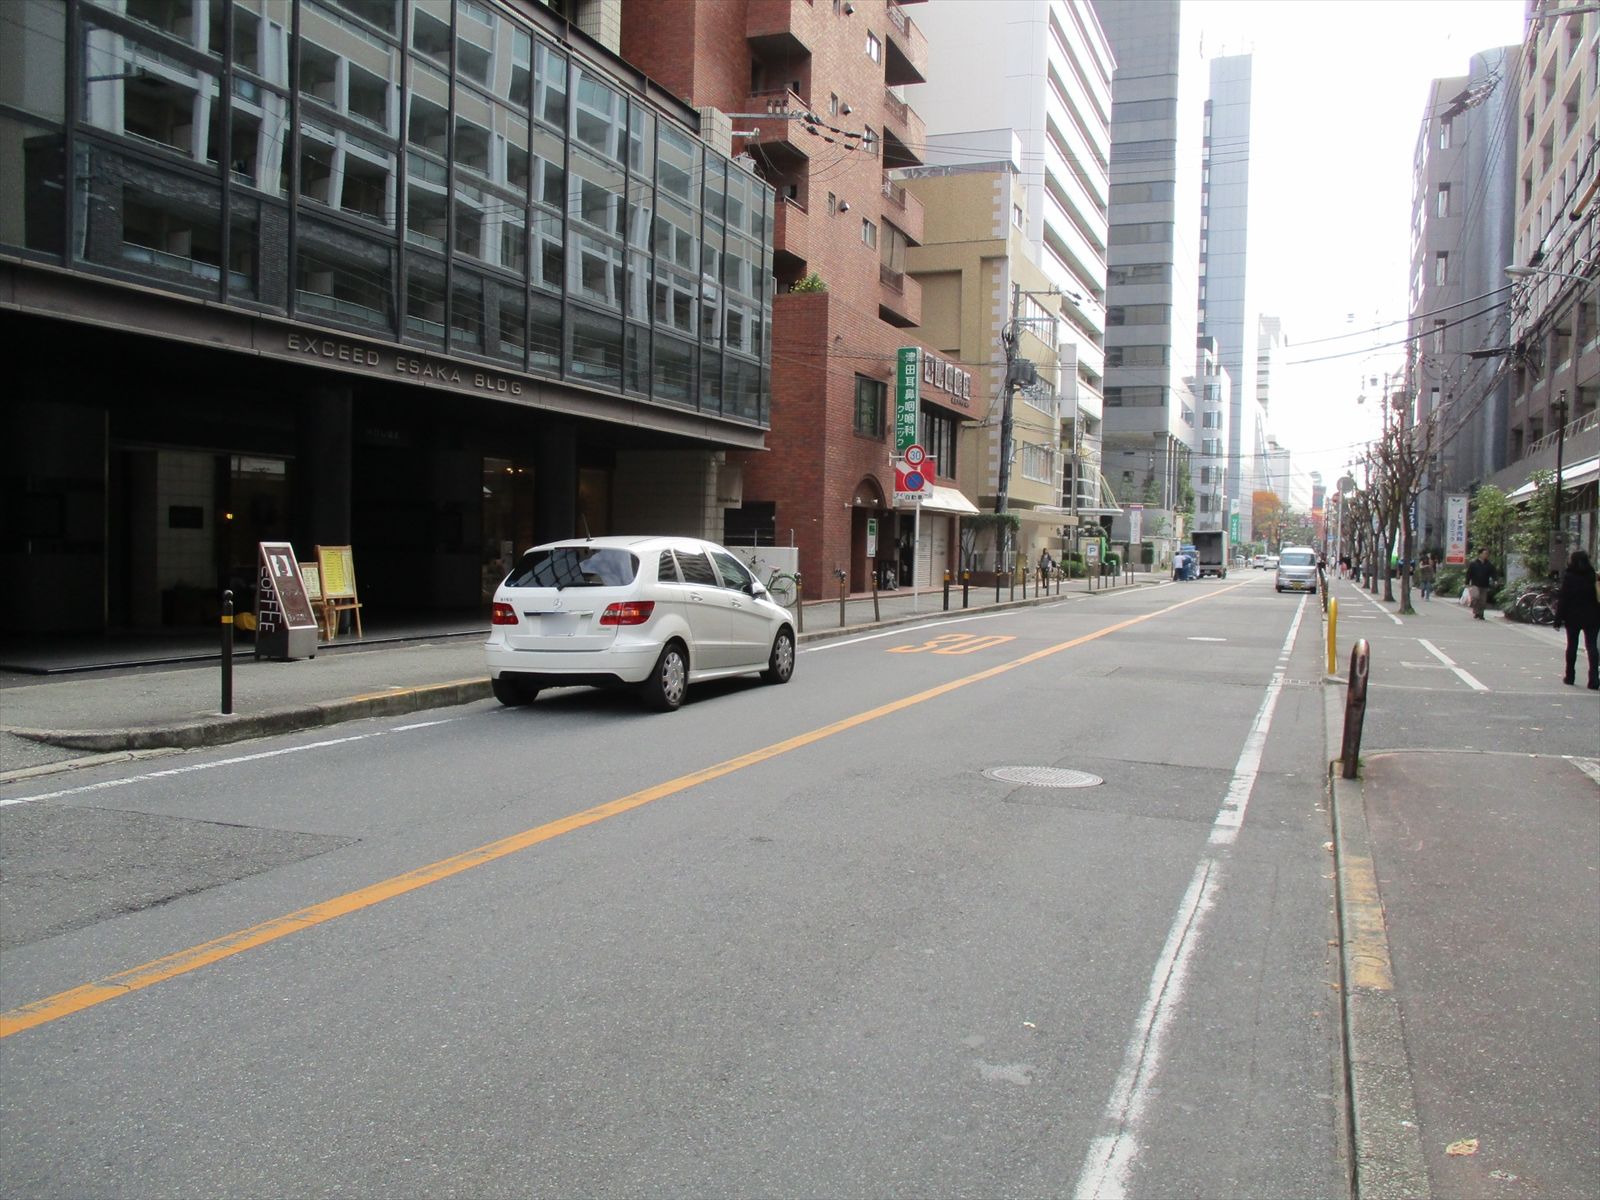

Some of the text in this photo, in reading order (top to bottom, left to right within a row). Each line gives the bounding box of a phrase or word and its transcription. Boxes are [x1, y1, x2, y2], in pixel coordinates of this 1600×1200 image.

[287, 334, 522, 395] EXCEED ESAKA BLDG
[904, 351, 916, 437] 津田耳鼻咽喉科
[897, 405, 905, 446] クリニック
[910, 451, 921, 460] 30
[259, 566, 282, 633] COFFEE
[884, 634, 1017, 655] 30
